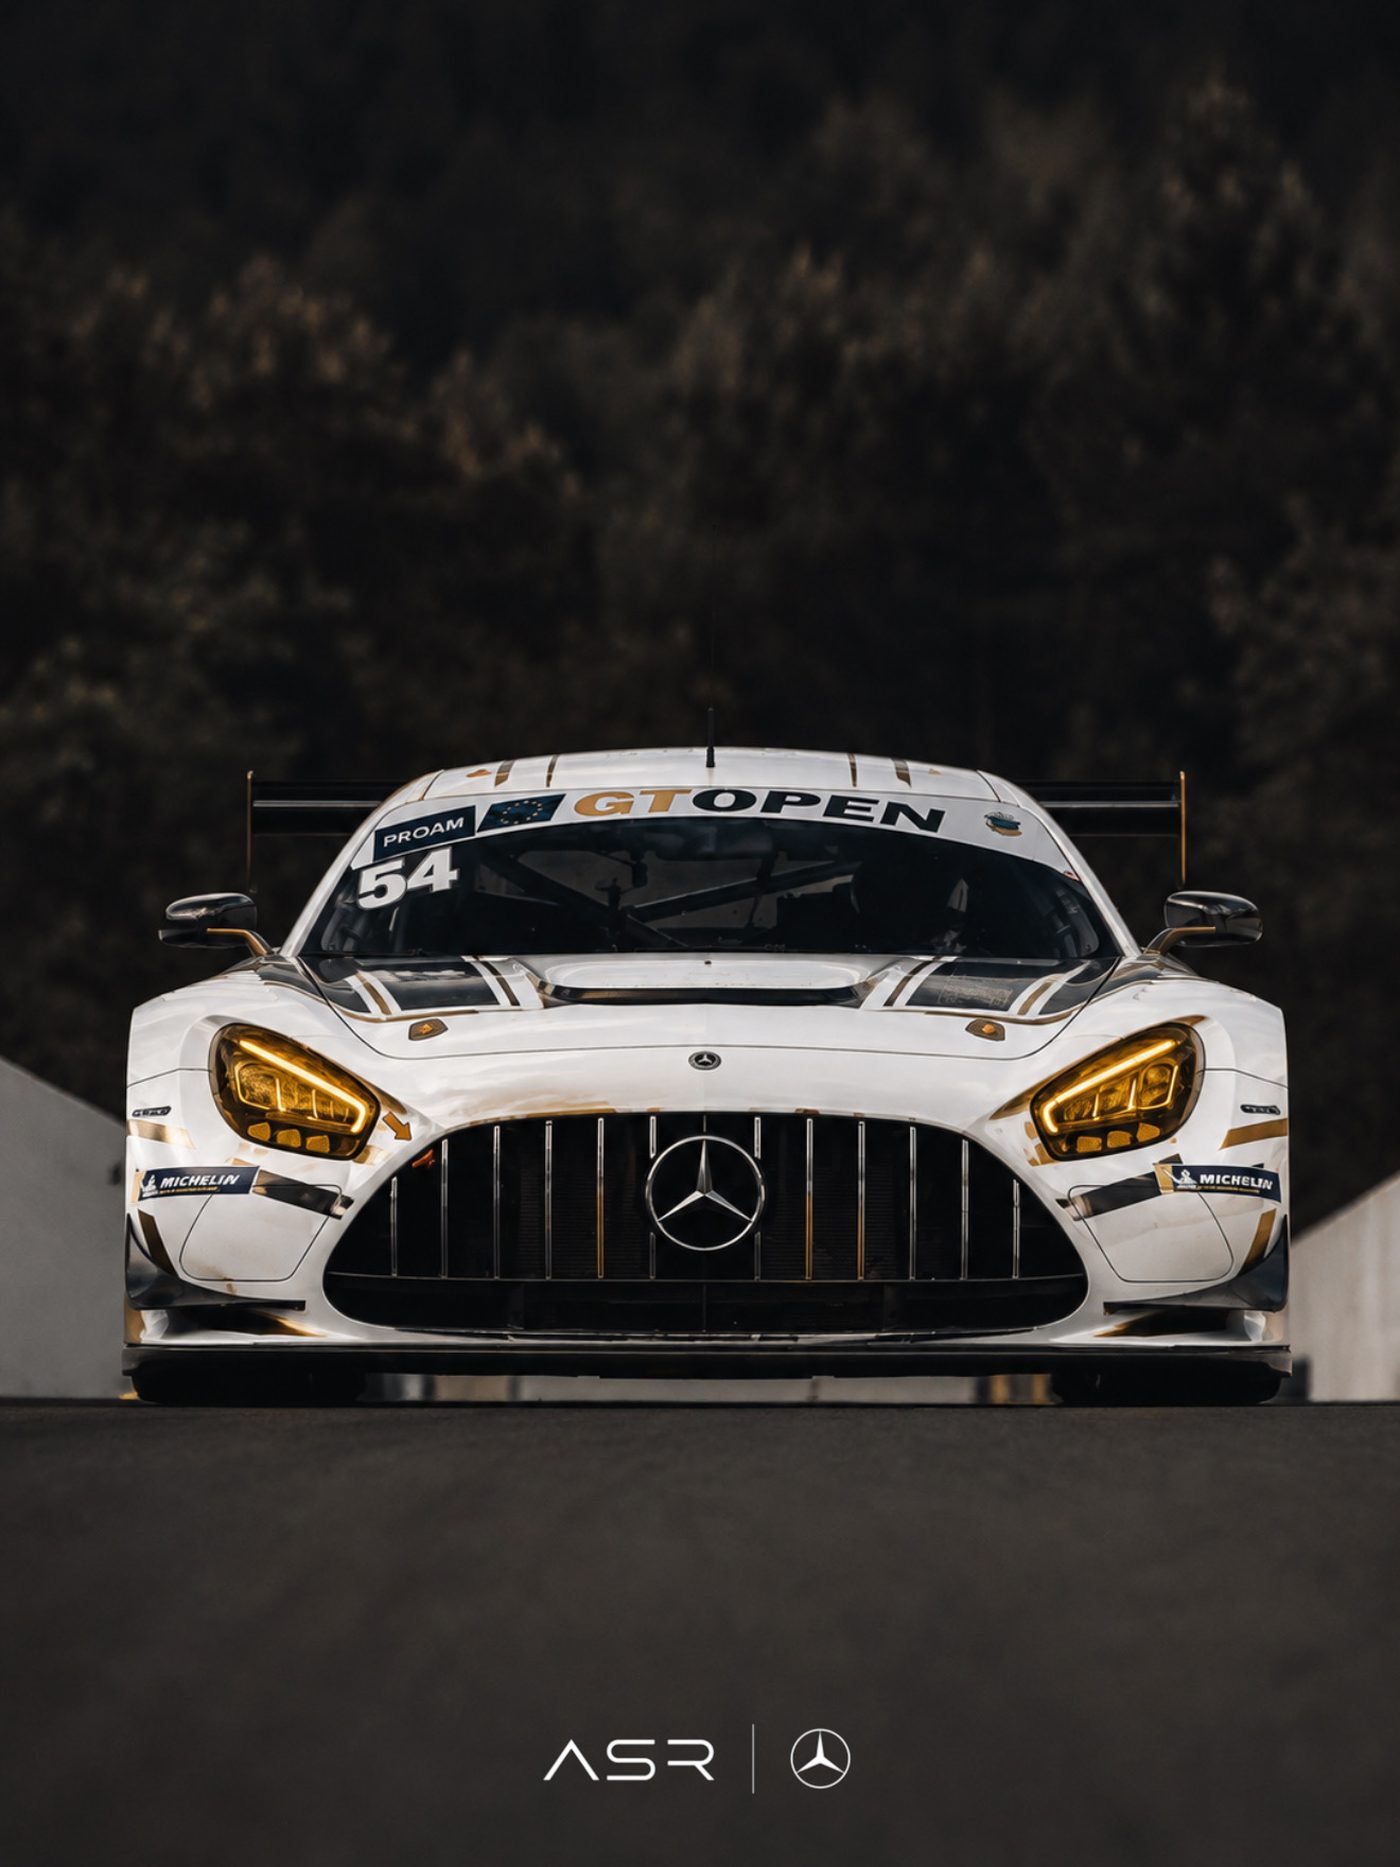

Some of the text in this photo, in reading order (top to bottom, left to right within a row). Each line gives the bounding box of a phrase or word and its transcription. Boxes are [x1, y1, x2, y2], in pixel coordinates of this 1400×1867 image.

[383, 817, 464, 848] PROAM
[357, 847, 458, 910] 54
[160, 1174, 241, 1188] MICHELIN
[1199, 1173, 1273, 1190] MICHELIN
